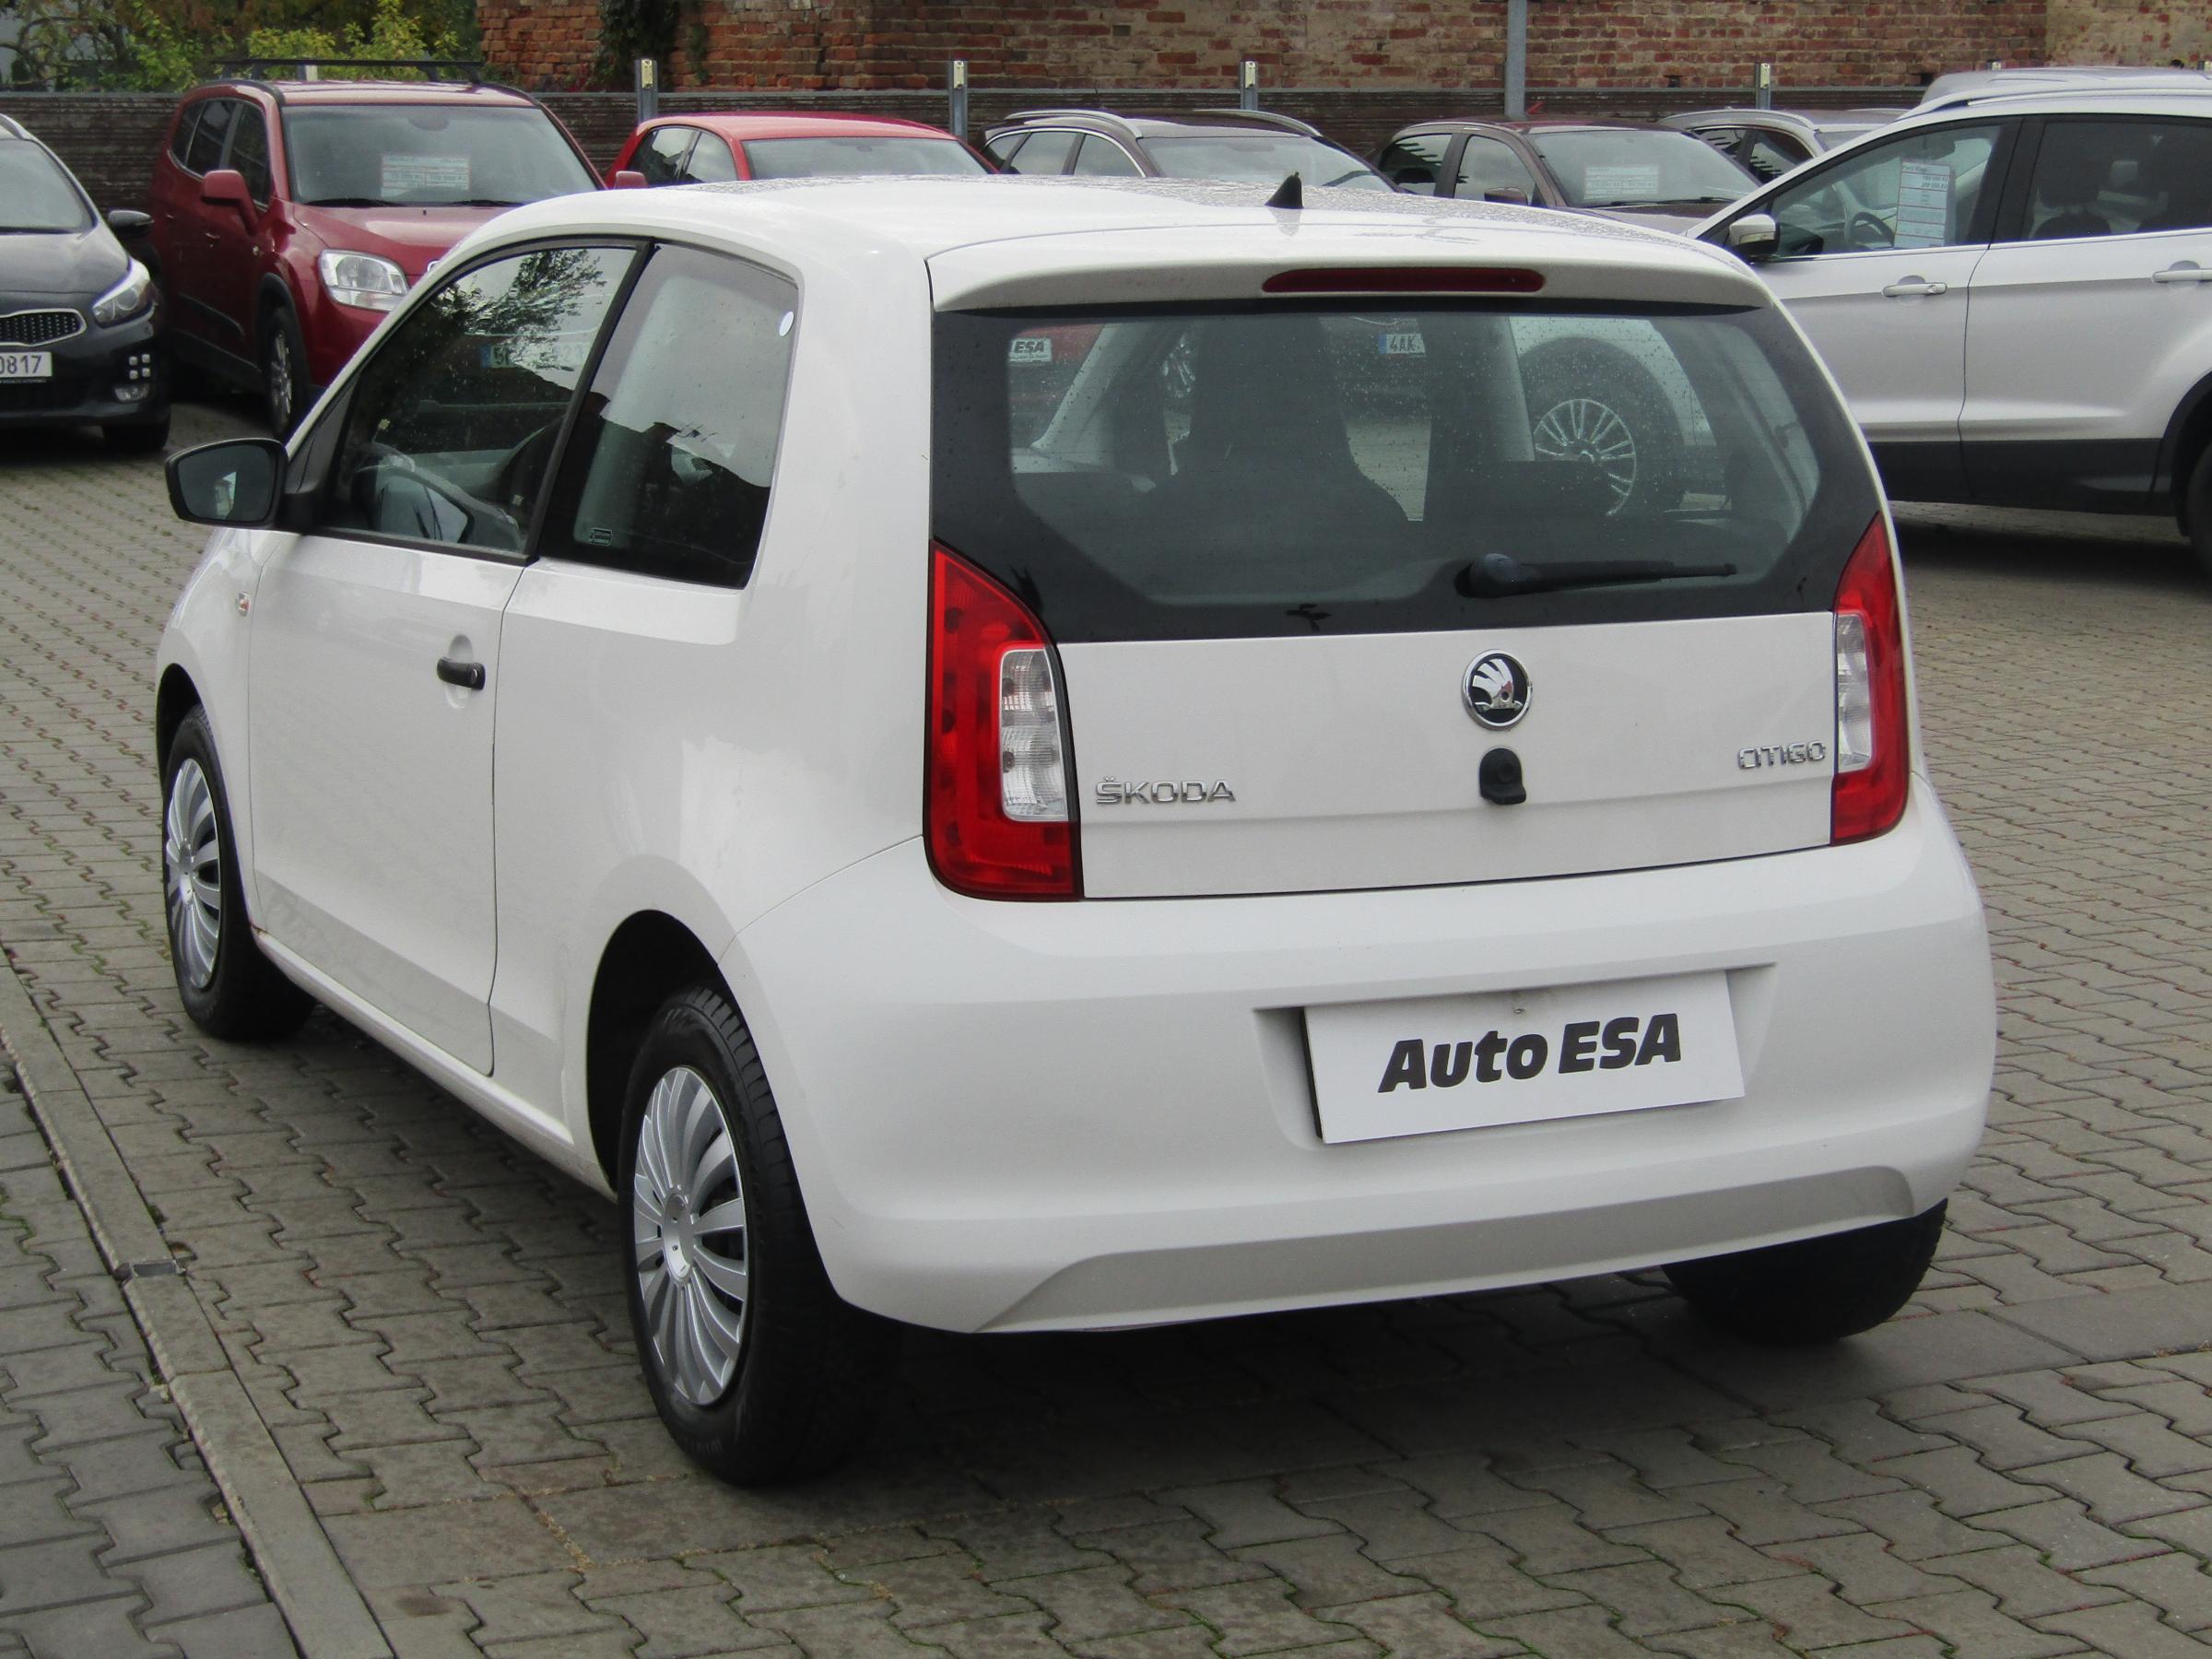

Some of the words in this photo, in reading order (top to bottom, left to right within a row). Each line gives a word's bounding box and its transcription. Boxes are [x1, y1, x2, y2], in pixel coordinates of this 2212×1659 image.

[1014, 341, 1044, 353] ESA
[1737, 740, 1826, 769] CITIGO
[1096, 776, 1236, 804] ŠKODA
[1378, 1030, 1548, 1093] Auto
[1559, 1013, 1681, 1074] ESA
